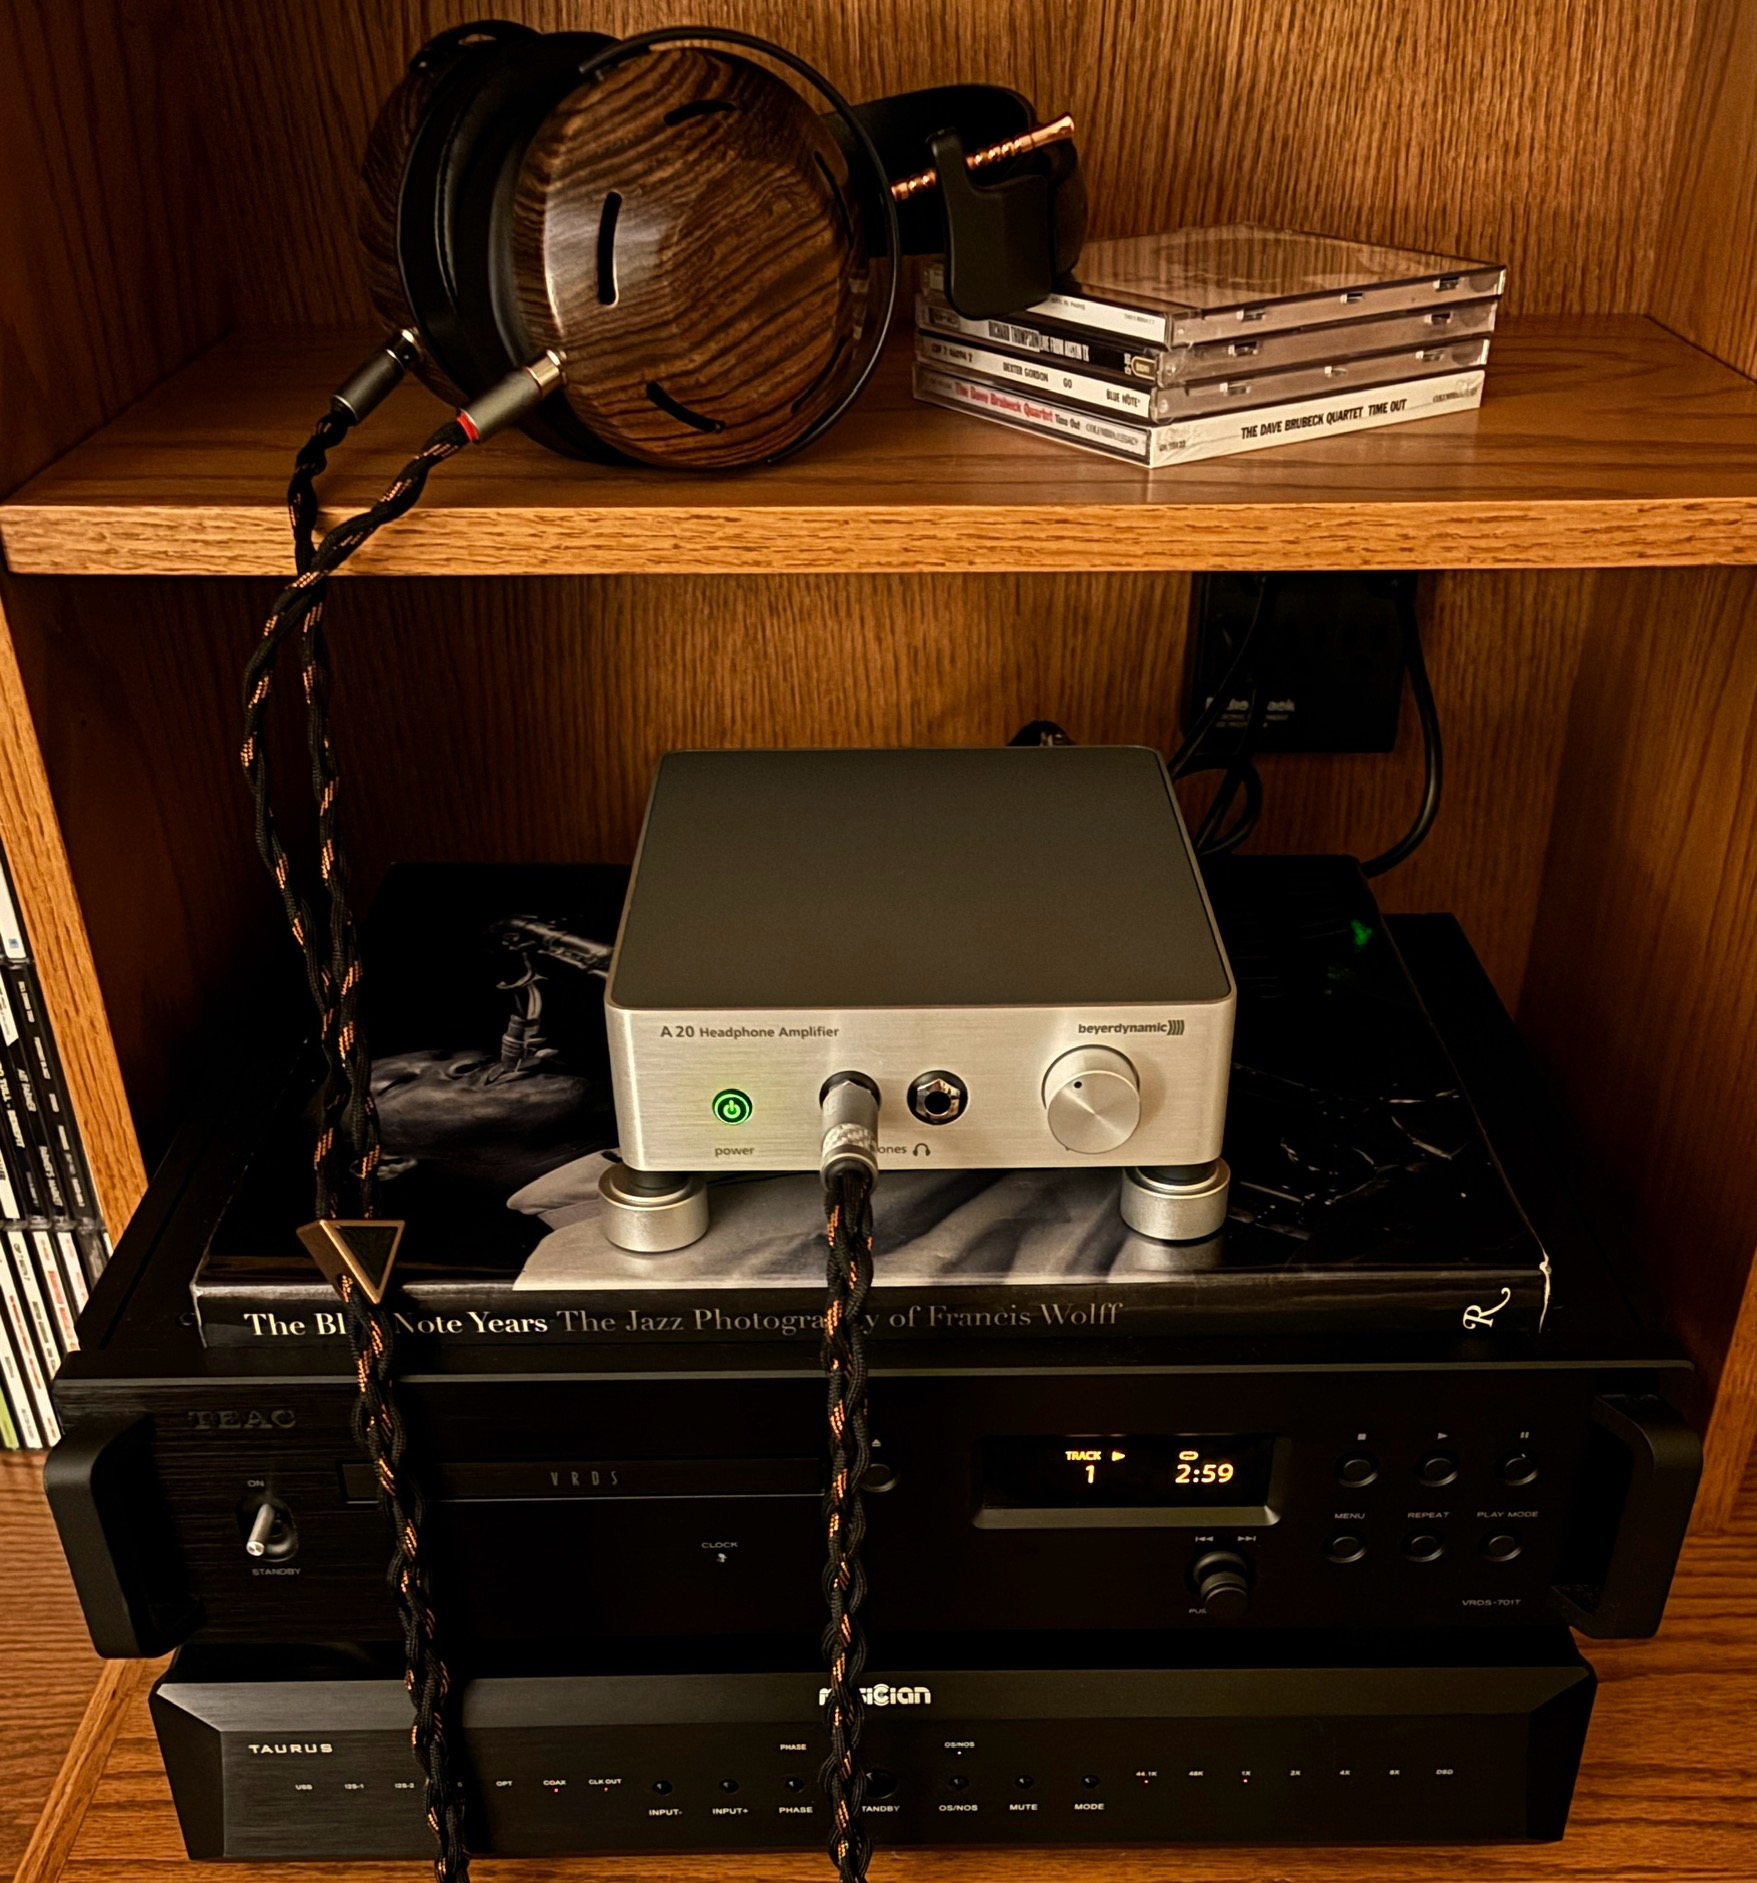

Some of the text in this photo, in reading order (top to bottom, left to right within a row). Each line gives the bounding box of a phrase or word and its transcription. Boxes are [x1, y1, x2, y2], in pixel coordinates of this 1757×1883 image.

[1003, 362, 1073, 389] DEXTER GORDON GO
[1106, 388, 1120, 404] BLUE
[954, 382, 970, 398] The
[990, 393, 1022, 413] Brubeck
[1023, 402, 1054, 422] Quartet
[1054, 414, 1068, 427] Time
[1069, 418, 1081, 430] Out
[1241, 399, 1407, 440] THE DAVE BRUBECK QUARTET TIME OUT
[660, 1024, 839, 1040] A 20 Headphone Amplifier
[1078, 1022, 1167, 1037] beyerdynamic
[714, 1146, 754, 1158] power
[878, 1145, 907, 1154] ones
[244, 1313, 305, 1336] The
[395, 1313, 463, 1335] Note
[467, 1312, 548, 1334] Years
[556, 1311, 616, 1333] The
[626, 1310, 684, 1333] Jazz
[694, 1309, 880, 1335] Photogray
[889, 1305, 916, 1328] of
[928, 1304, 1031, 1328] Francis
[1040, 1302, 1122, 1327] Wolff
[189, 1410, 296, 1429] TEAC
[1065, 1451, 1101, 1461] TRACK
[551, 1471, 618, 1486] VRDS
[1085, 1465, 1095, 1483] 1
[1175, 1463, 1234, 1483] 2:59
[252, 1568, 301, 1576] STANDBY
[248, 1743, 333, 1754] TAURUS
